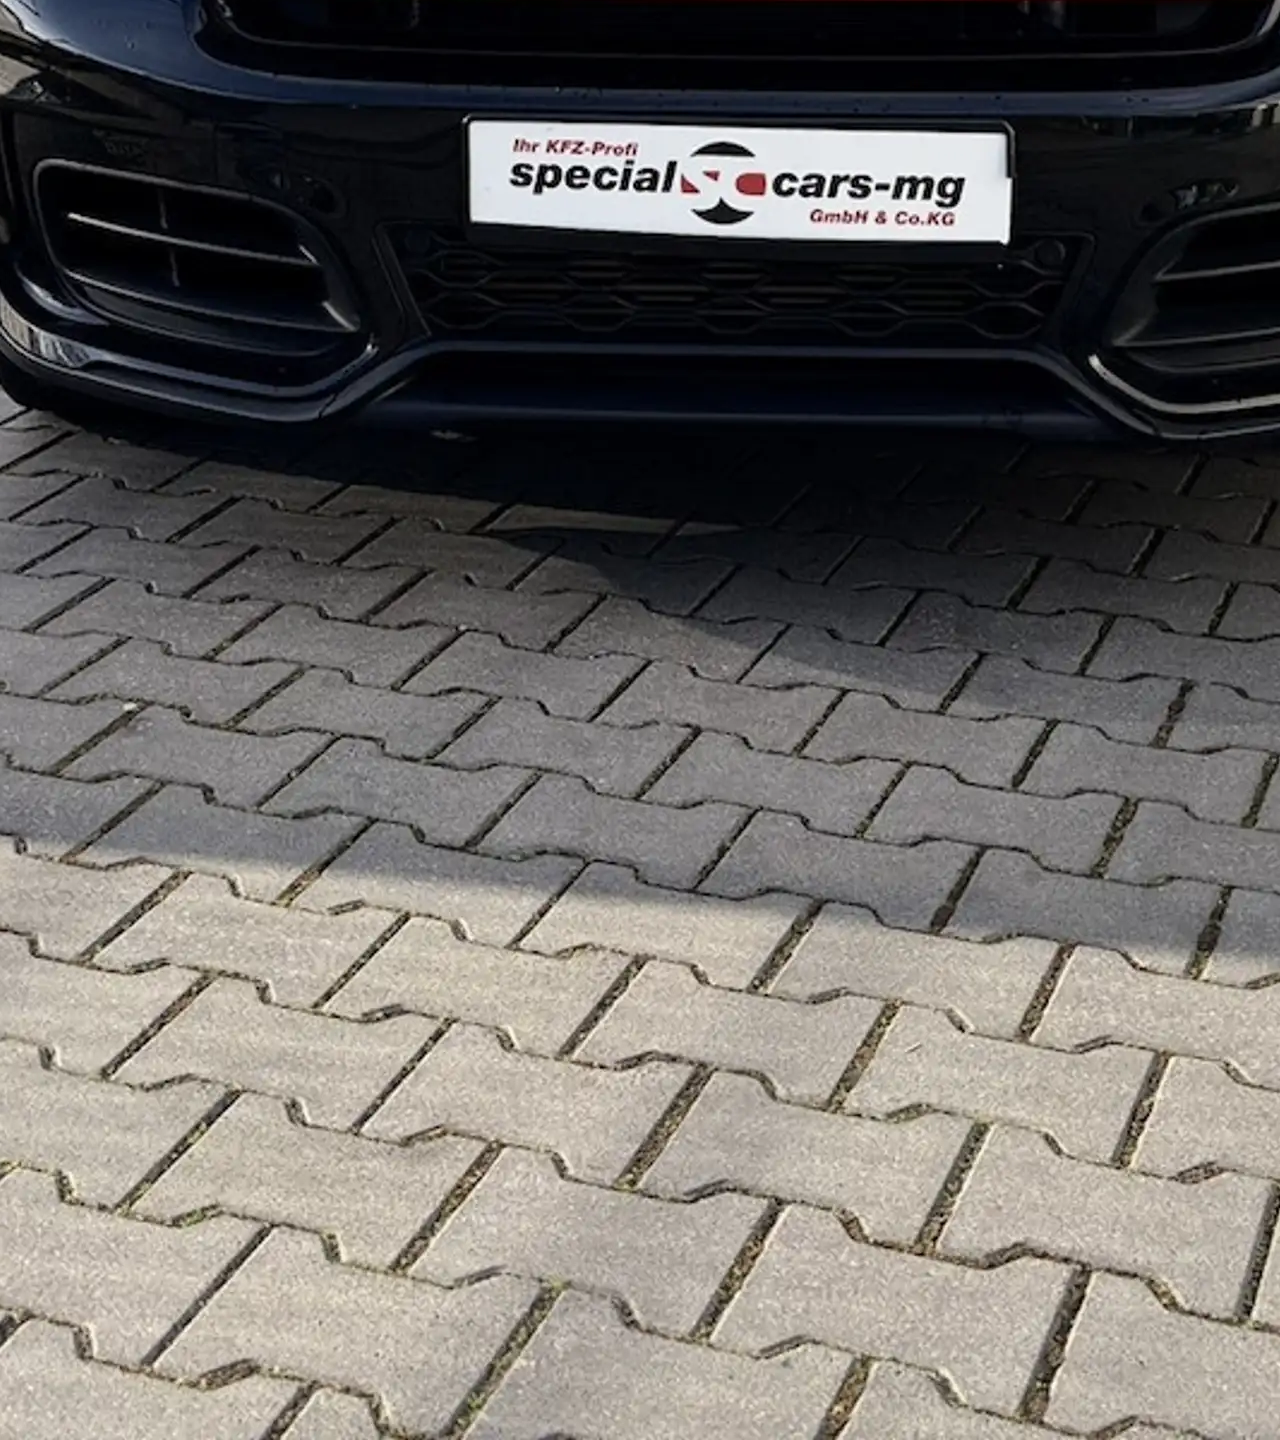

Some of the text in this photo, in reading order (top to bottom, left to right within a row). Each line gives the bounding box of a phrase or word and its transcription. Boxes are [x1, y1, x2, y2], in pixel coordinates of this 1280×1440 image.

[512, 139, 639, 157] Ihr KFZ-Profi
[509, 160, 966, 209] special cars-mg
[809, 209, 956, 227] GmbH & Co.KG
